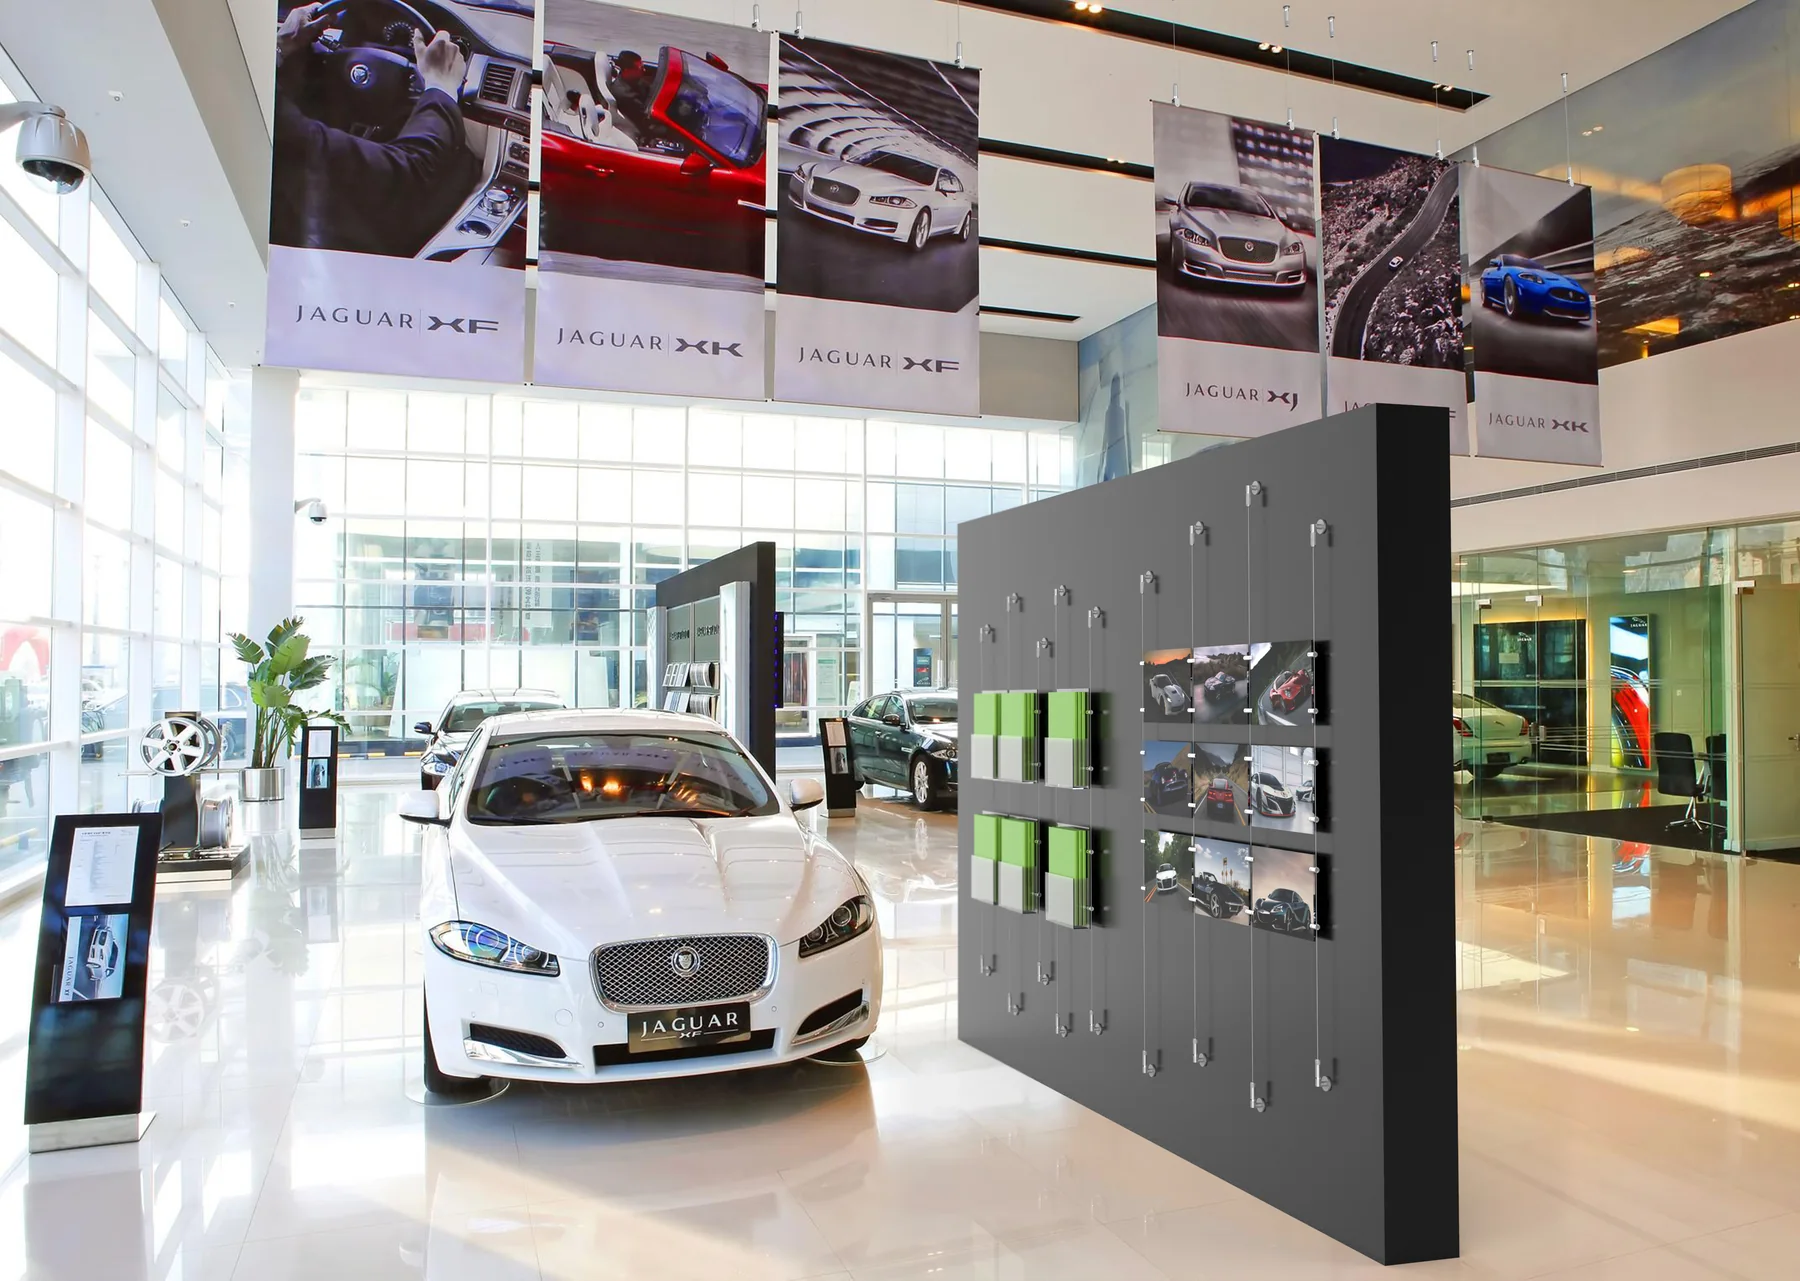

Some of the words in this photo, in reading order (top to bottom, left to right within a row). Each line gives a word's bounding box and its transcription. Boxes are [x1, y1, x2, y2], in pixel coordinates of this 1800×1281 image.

[296, 304, 413, 329] JAGUAR
[426, 315, 500, 334] XF
[556, 328, 663, 351] JAGUAR
[674, 337, 744, 358] XK
[798, 346, 892, 369] JAGUAR
[902, 356, 960, 373] XF
[1185, 382, 1259, 402] JAGUAR
[1267, 390, 1299, 412] XJ
[1488, 412, 1545, 429] JAGUAR
[1551, 418, 1590, 433] XK
[65, 957, 74, 986] JAGUAR
[641, 1012, 738, 1038] JAGUAR
[680, 1031, 702, 1039] XF
